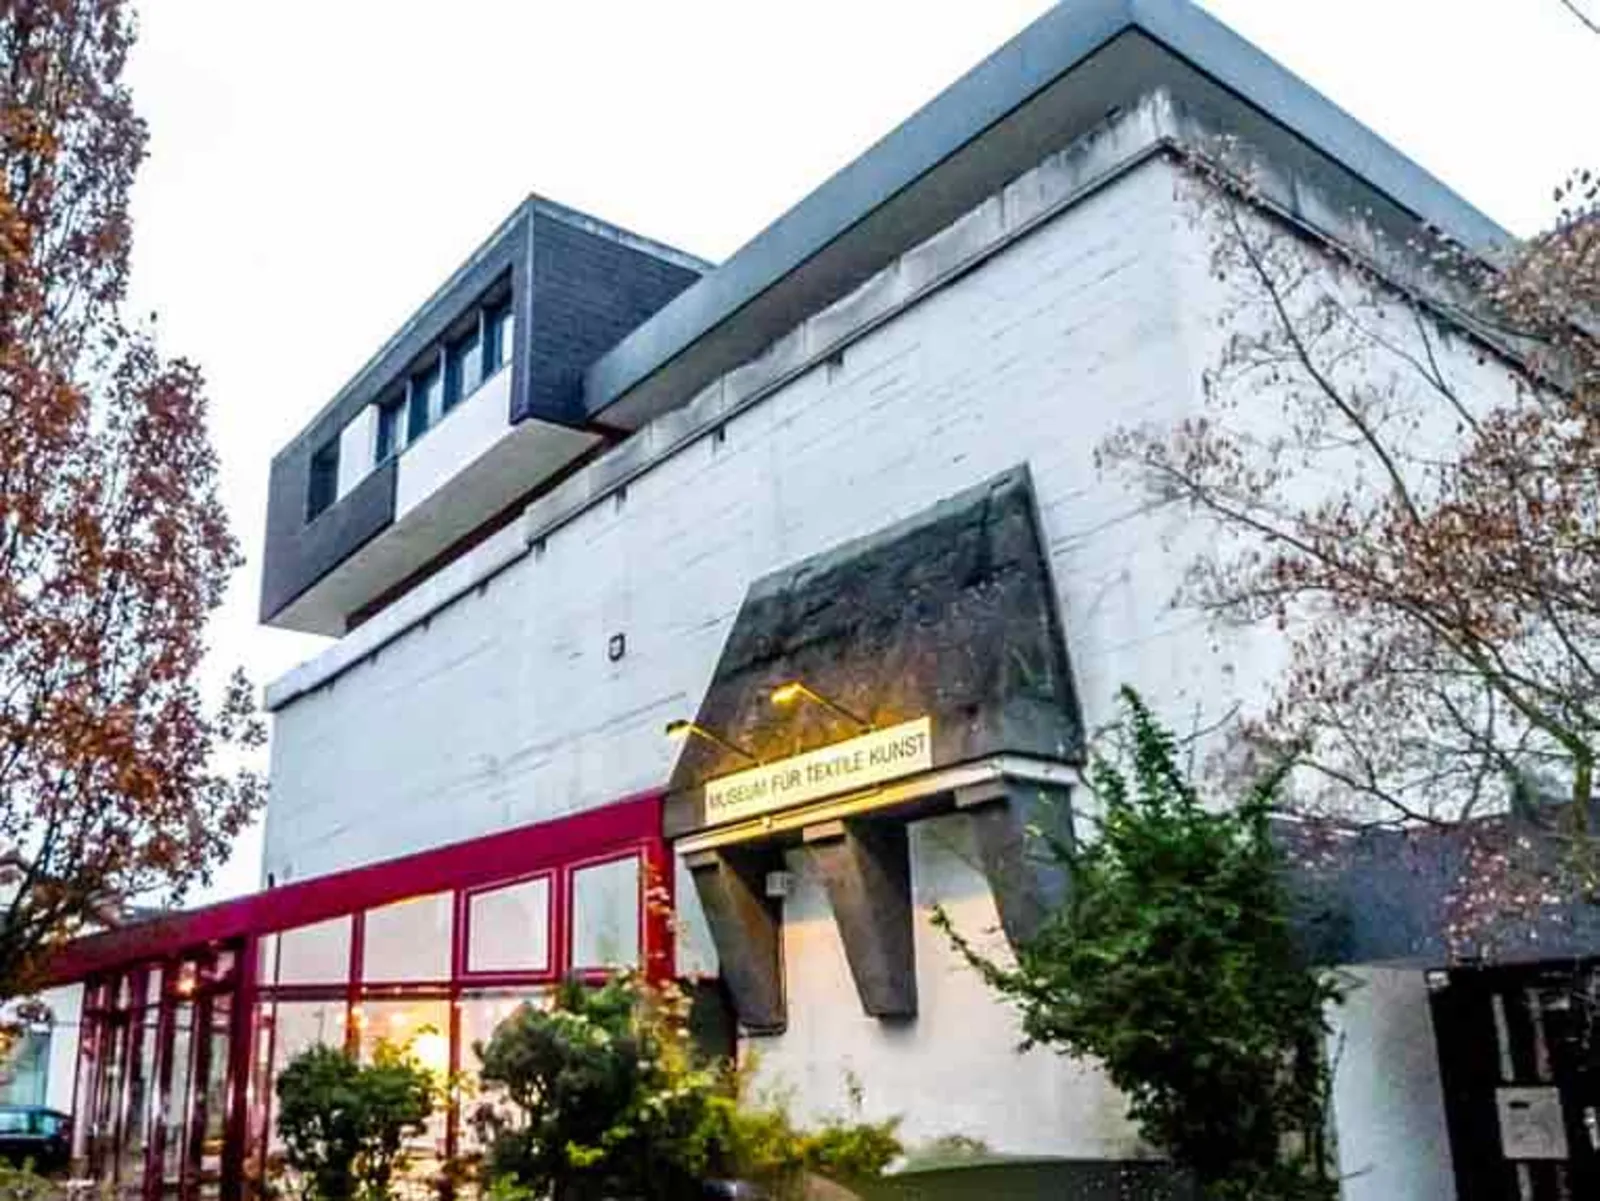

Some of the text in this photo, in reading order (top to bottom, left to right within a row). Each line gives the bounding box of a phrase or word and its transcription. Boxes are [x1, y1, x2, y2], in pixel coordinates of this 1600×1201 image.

[709, 733, 926, 810] MUSEUM FÜR TEXTILE KUNST
